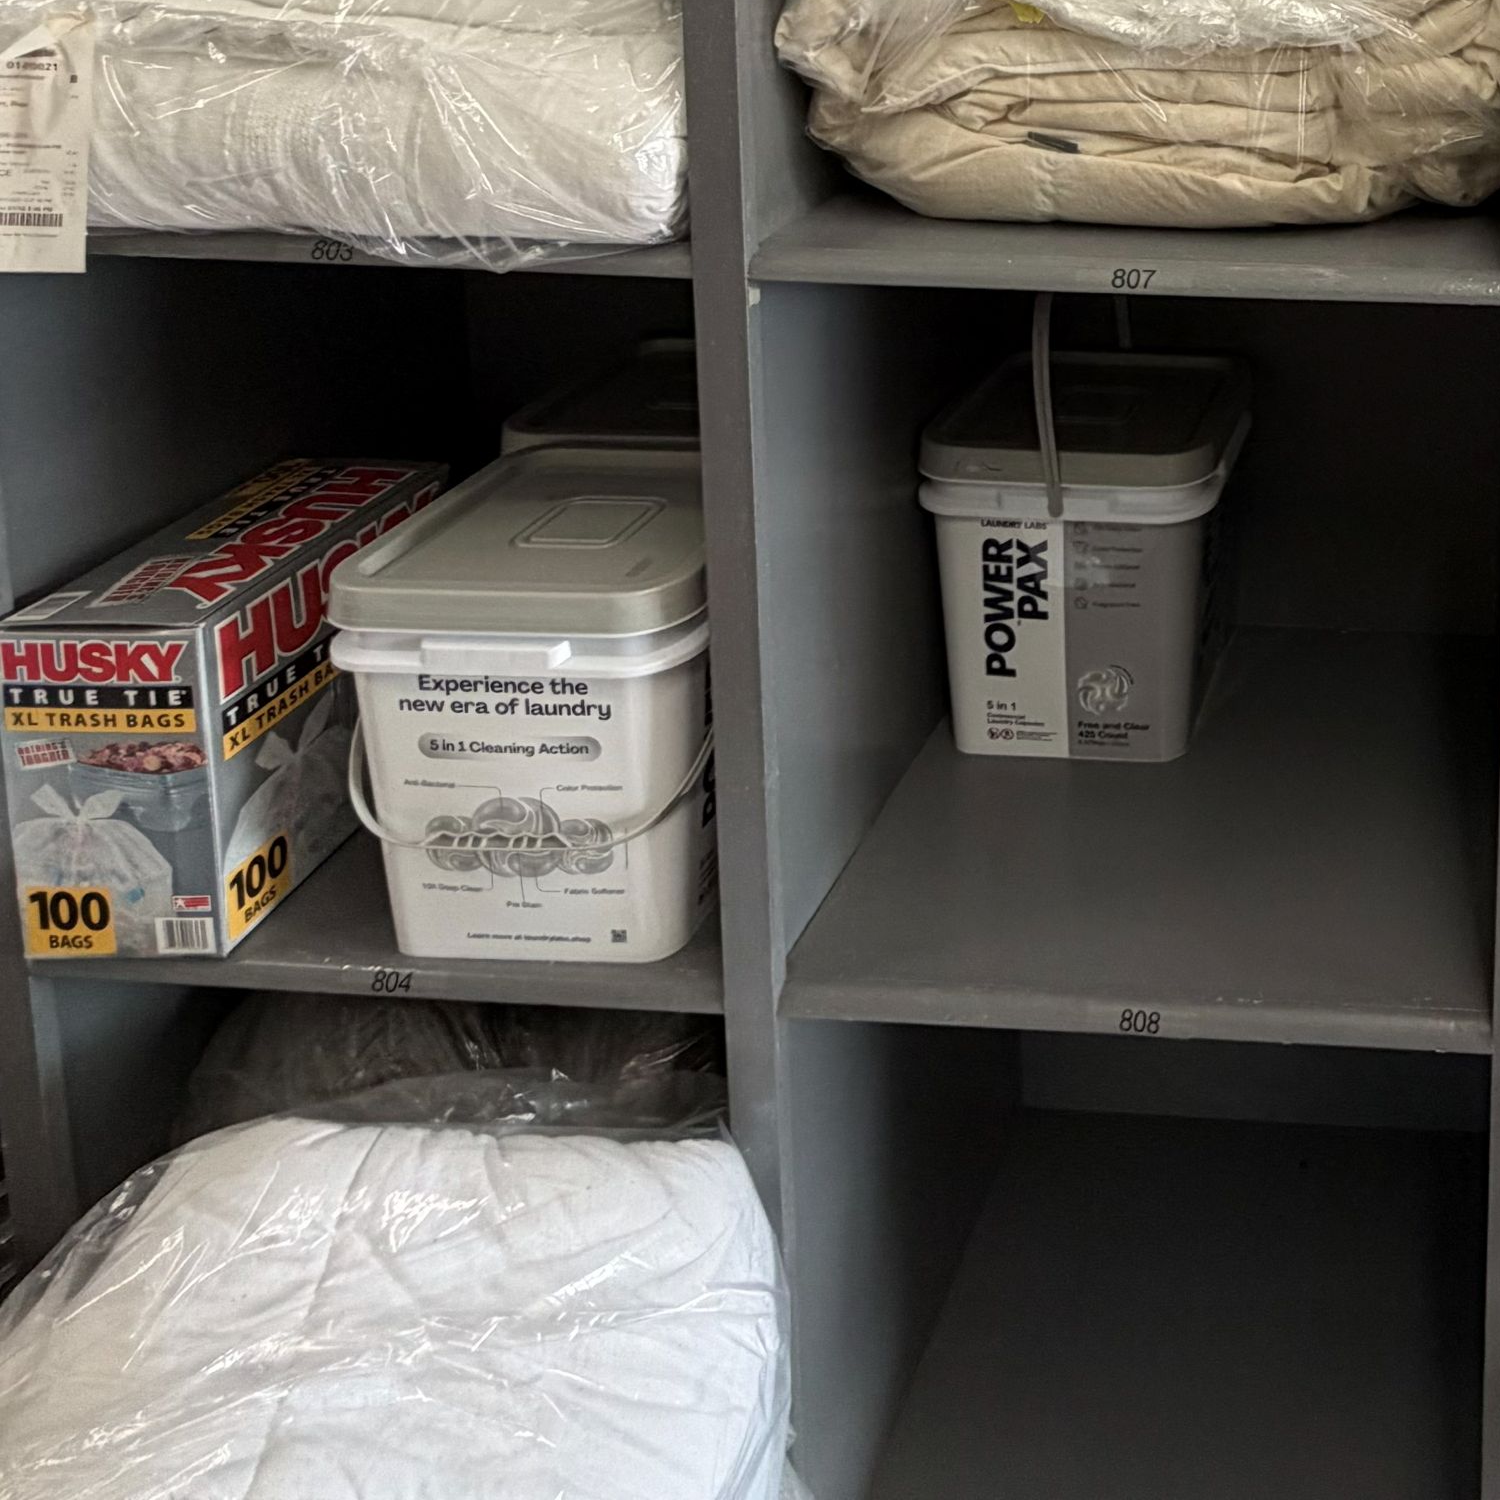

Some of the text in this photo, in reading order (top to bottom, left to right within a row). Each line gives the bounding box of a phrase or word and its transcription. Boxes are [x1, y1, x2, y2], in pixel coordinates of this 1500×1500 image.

[312, 241, 352, 261] 803
[1111, 268, 1156, 289] 807
[1024, 521, 1047, 530] LABS
[1016, 539, 1049, 620] PAX
[982, 537, 1017, 678] POWER
[1, 640, 187, 682] HUSKY
[226, 666, 297, 726] TRUE
[418, 674, 588, 696] Experience the
[9, 688, 99, 706] TRUE
[228, 726, 252, 751] XL
[256, 683, 309, 729] TRASH
[399, 698, 612, 720] new era of laundry
[12, 713, 185, 729] XL TRASH BAGS
[430, 739, 589, 757] 5 in 1 Cleaning Action
[229, 835, 288, 911] 100
[29, 891, 111, 931] 100
[244, 885, 277, 923] BAGS
[49, 935, 94, 948] BAGS
[371, 970, 414, 993] 804
[1120, 1008, 1160, 1034] 808
